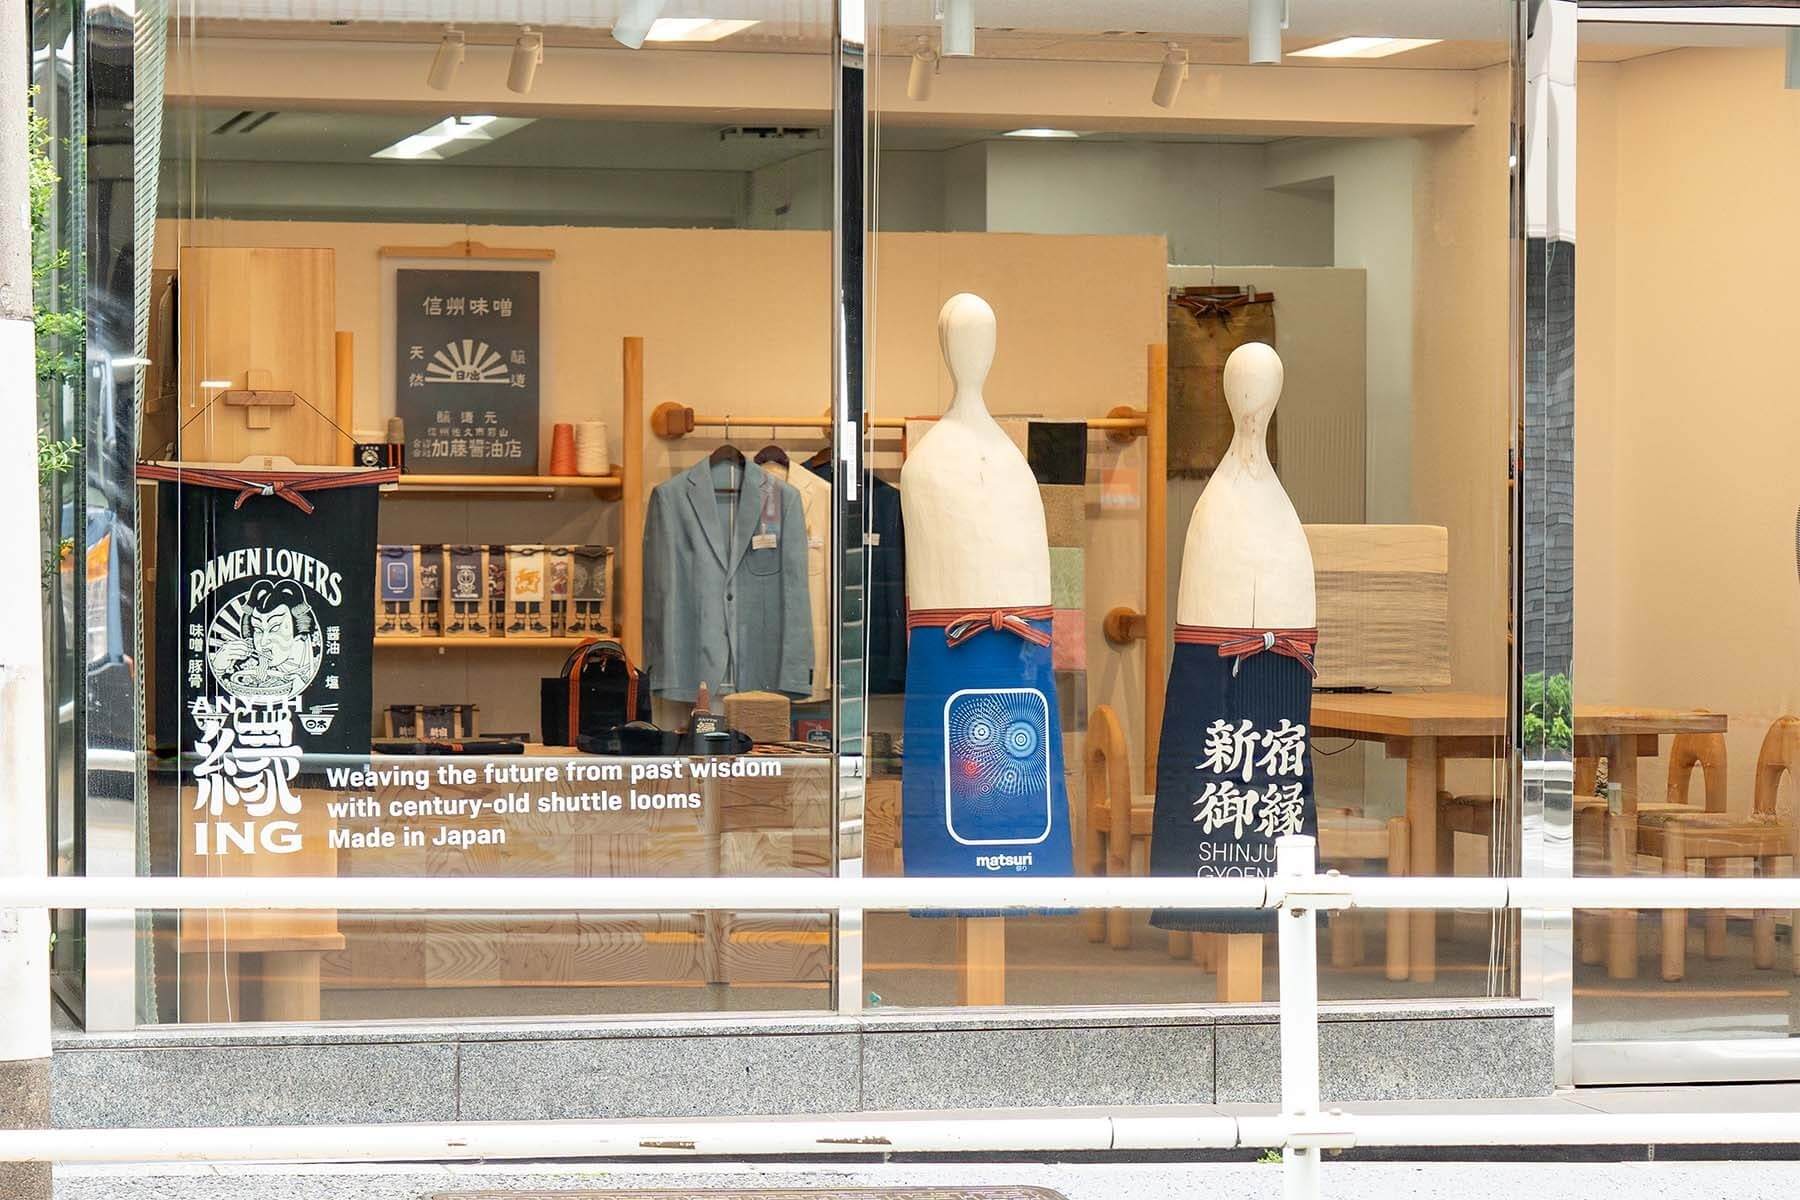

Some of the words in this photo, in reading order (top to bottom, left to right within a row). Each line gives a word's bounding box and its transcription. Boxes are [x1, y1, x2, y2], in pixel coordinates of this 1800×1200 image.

[189, 547, 262, 614] RAMEN
[265, 547, 343, 607] LOVERS
[1195, 718, 1306, 783] 新宿
[326, 765, 430, 791] Weaving
[437, 764, 477, 785] the
[483, 763, 559, 784] future
[565, 761, 623, 782] from
[630, 760, 683, 784] past
[689, 757, 782, 778] wisdom
[327, 796, 381, 818] with
[389, 793, 530, 819] century-old
[537, 790, 622, 812] shuttle
[630, 789, 701, 810] looms
[193, 820, 303, 855] ING
[328, 827, 396, 849] Made
[403, 826, 425, 846] in
[432, 826, 506, 849] Japan
[976, 852, 1033, 871] matsuri
